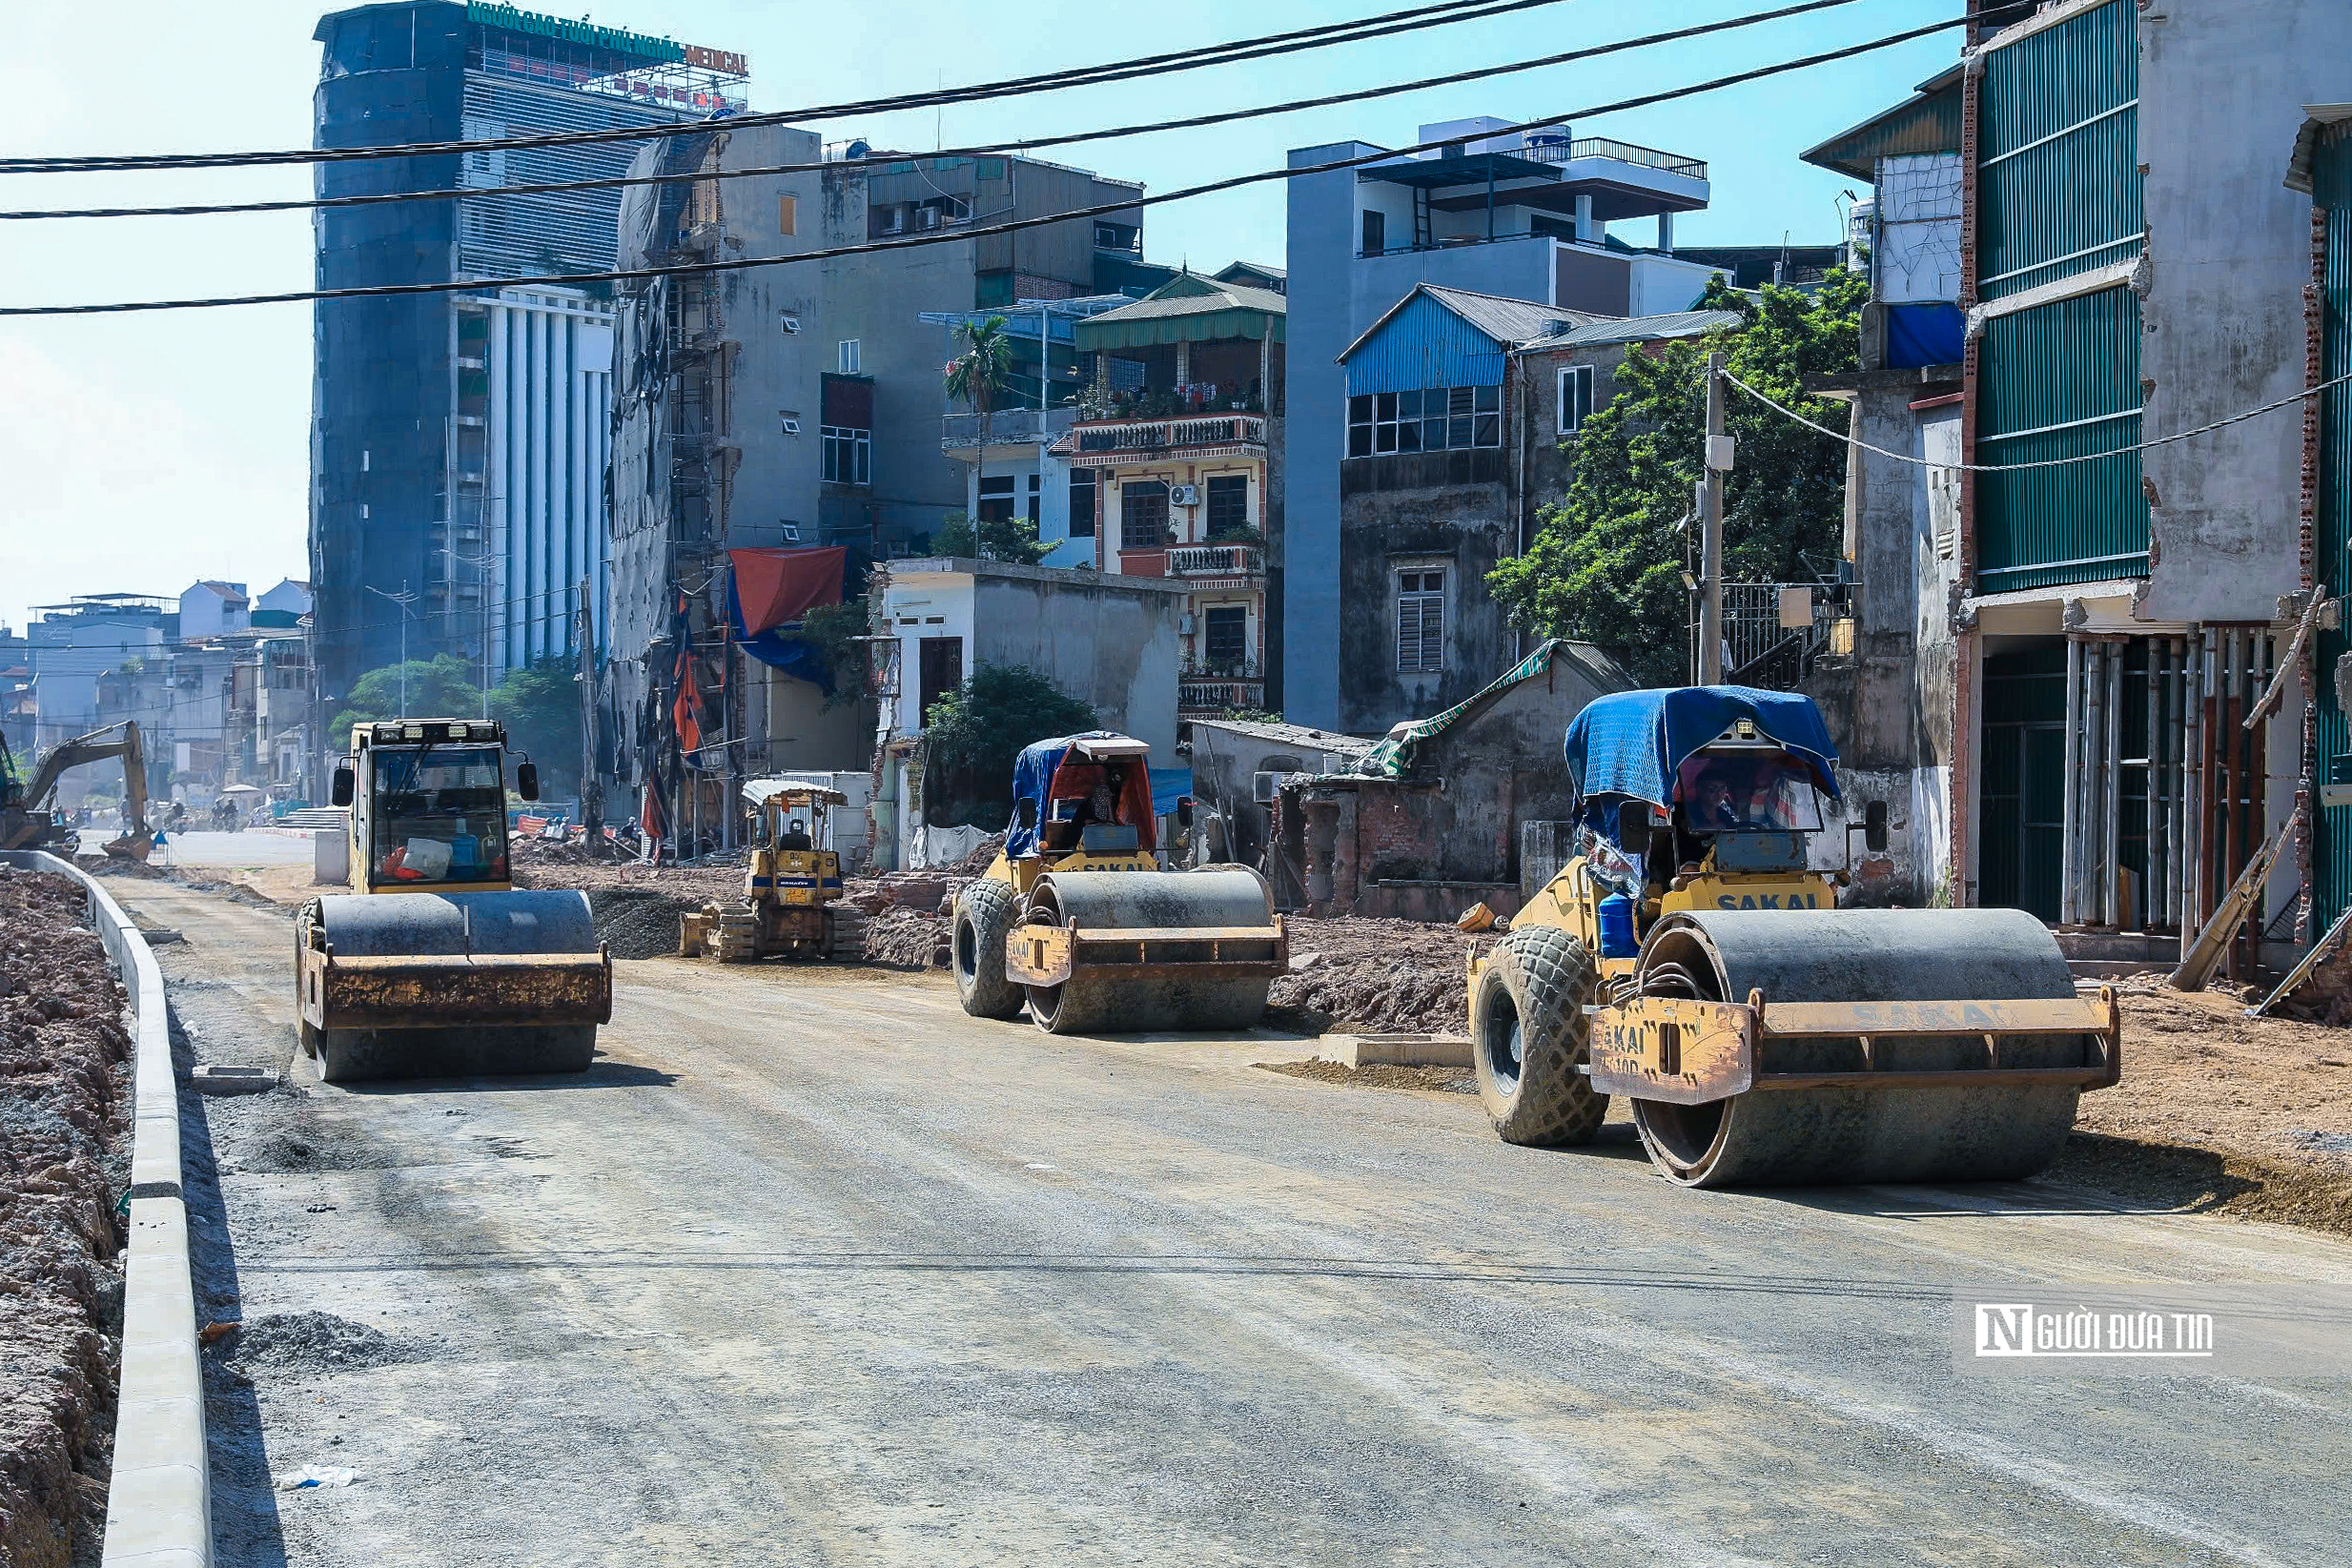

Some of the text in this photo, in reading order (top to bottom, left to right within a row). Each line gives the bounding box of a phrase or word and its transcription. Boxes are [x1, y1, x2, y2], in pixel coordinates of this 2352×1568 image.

[467, 0, 520, 30] NGƯỜI
[523, 10, 555, 36] CAO
[559, 13, 596, 44] TUỔI
[684, 44, 749, 76] MEDICAL
[1717, 894, 1817, 910] SAKAI
